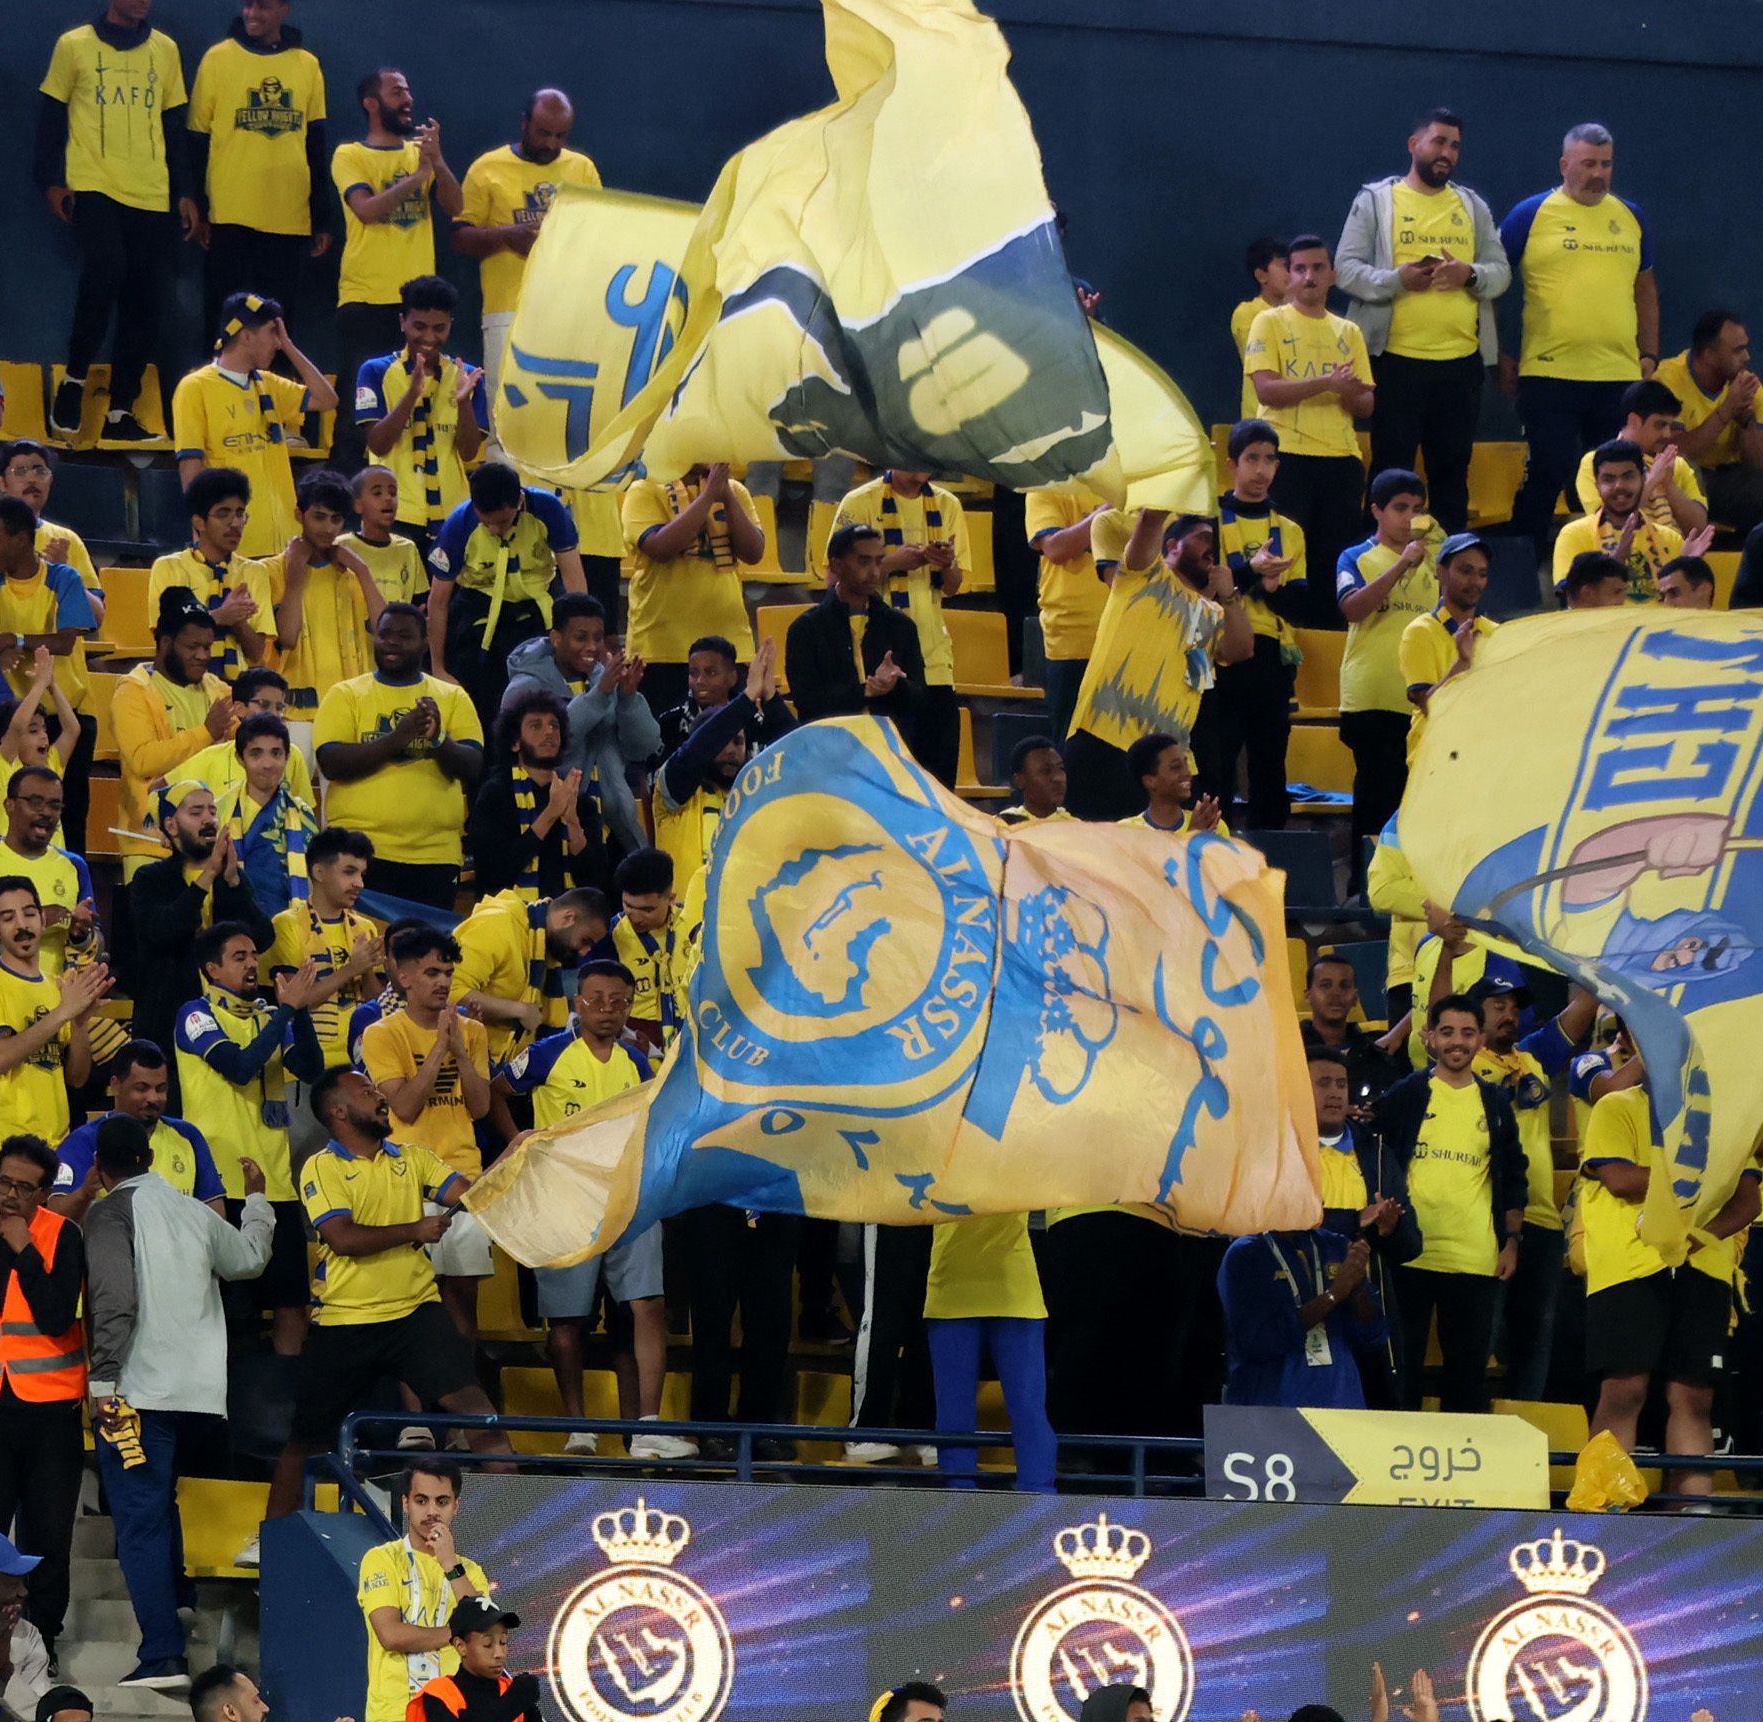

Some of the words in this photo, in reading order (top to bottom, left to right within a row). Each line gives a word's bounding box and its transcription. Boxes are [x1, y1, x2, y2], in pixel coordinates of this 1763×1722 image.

[95, 85, 155, 110] KAFD
[1285, 359, 1333, 378] KAF
[886, 894, 997, 1061] NASSR
[698, 1000, 769, 1066] CLUB
[1431, 1149, 1483, 1168] SHURFAH
[1223, 1451, 1297, 1502] S8
[1390, 1437, 1484, 1481] خروج
